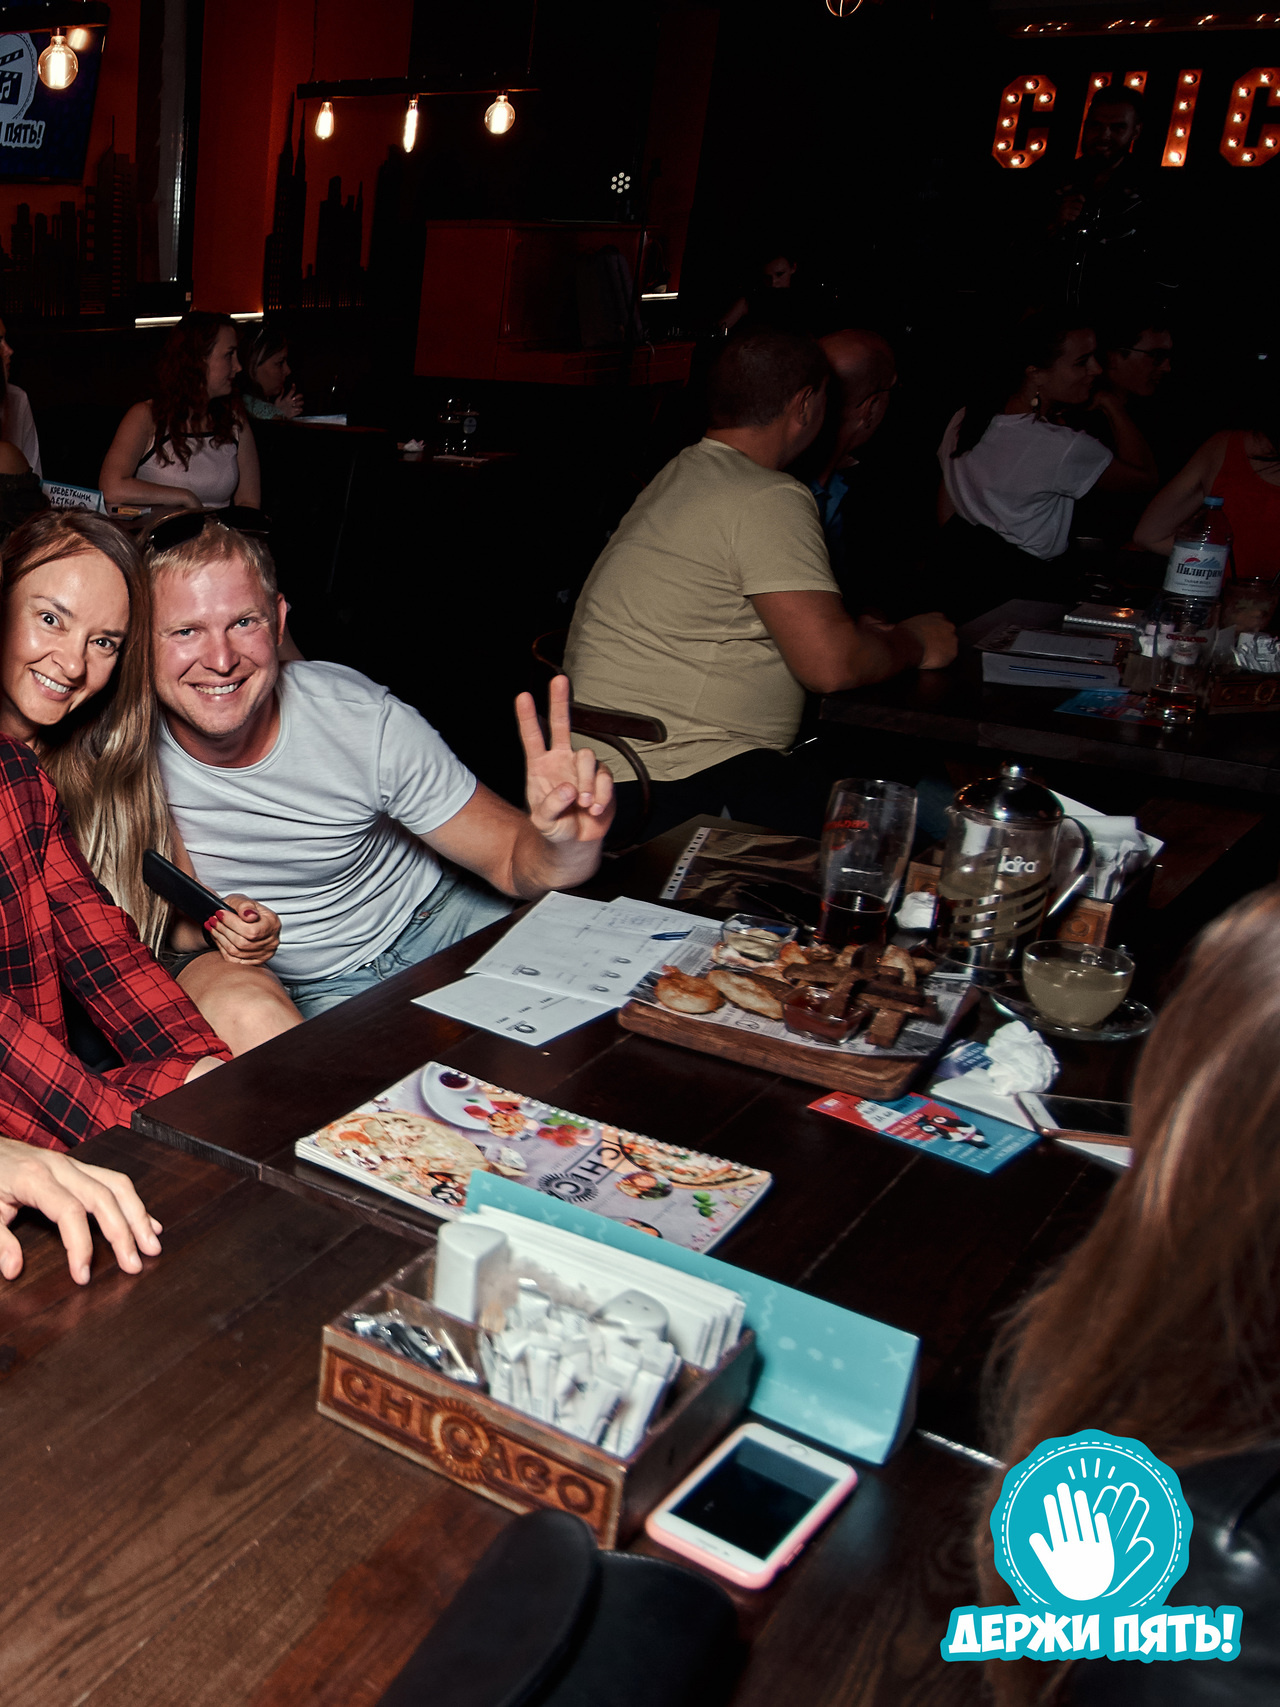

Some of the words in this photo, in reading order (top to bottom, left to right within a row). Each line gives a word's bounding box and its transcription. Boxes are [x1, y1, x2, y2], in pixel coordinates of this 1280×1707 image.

[4, 122, 43, 145] ПЯТЬ!
[1175, 563, 1223, 580] Пилигрим
[340, 1367, 595, 1515] CHICAGO
